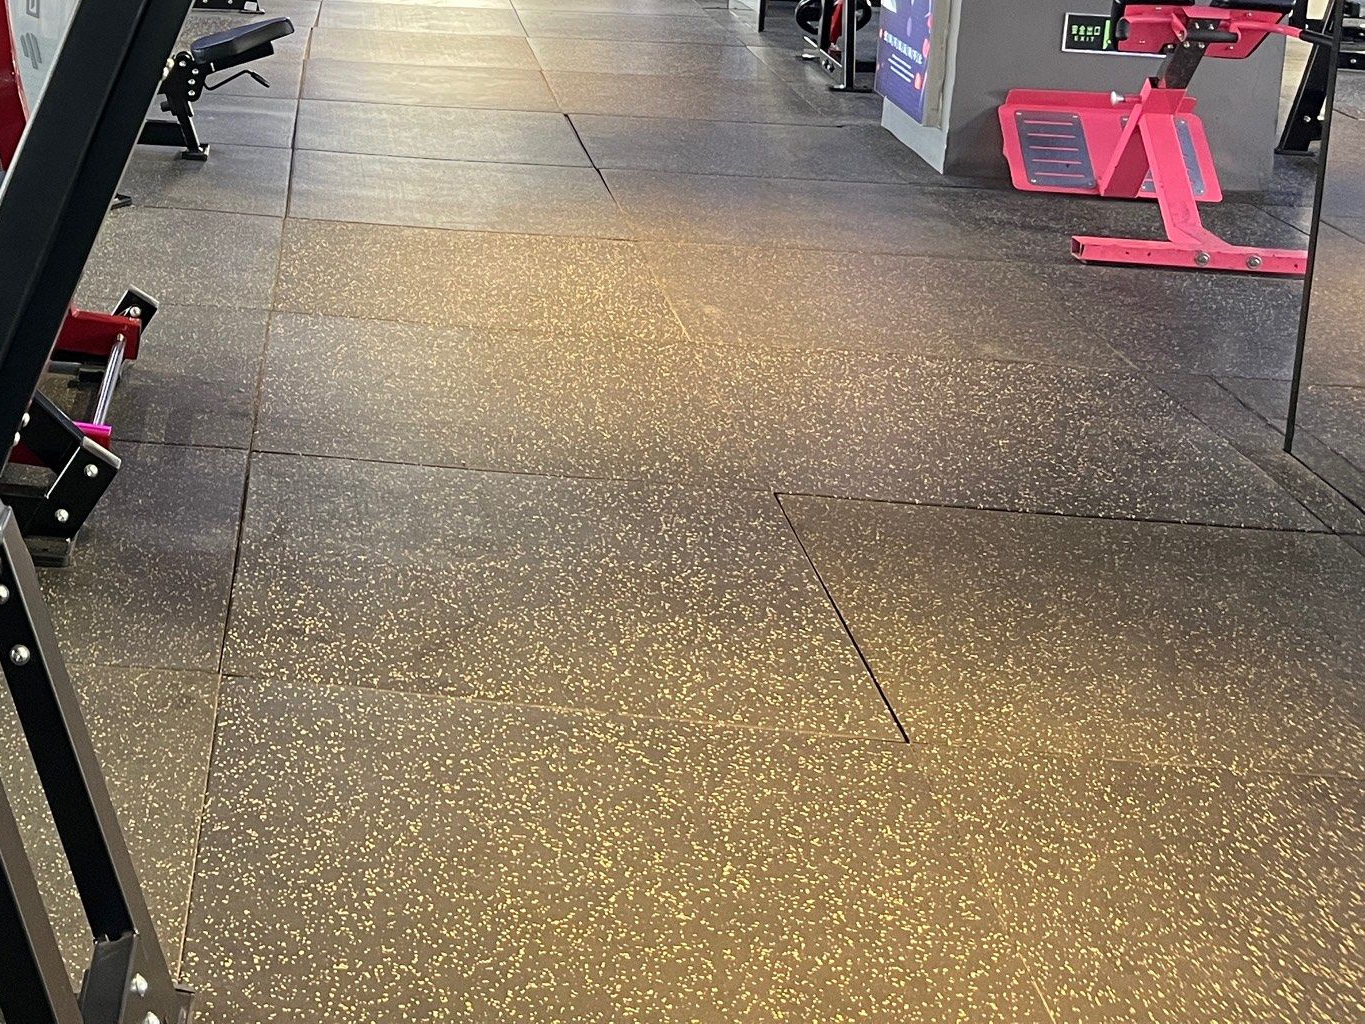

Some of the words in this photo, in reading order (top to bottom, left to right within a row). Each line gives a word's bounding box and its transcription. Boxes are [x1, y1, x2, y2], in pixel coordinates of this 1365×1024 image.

[1071, 24, 1101, 36] 安全出口
[1074, 35, 1095, 43] EXIT
